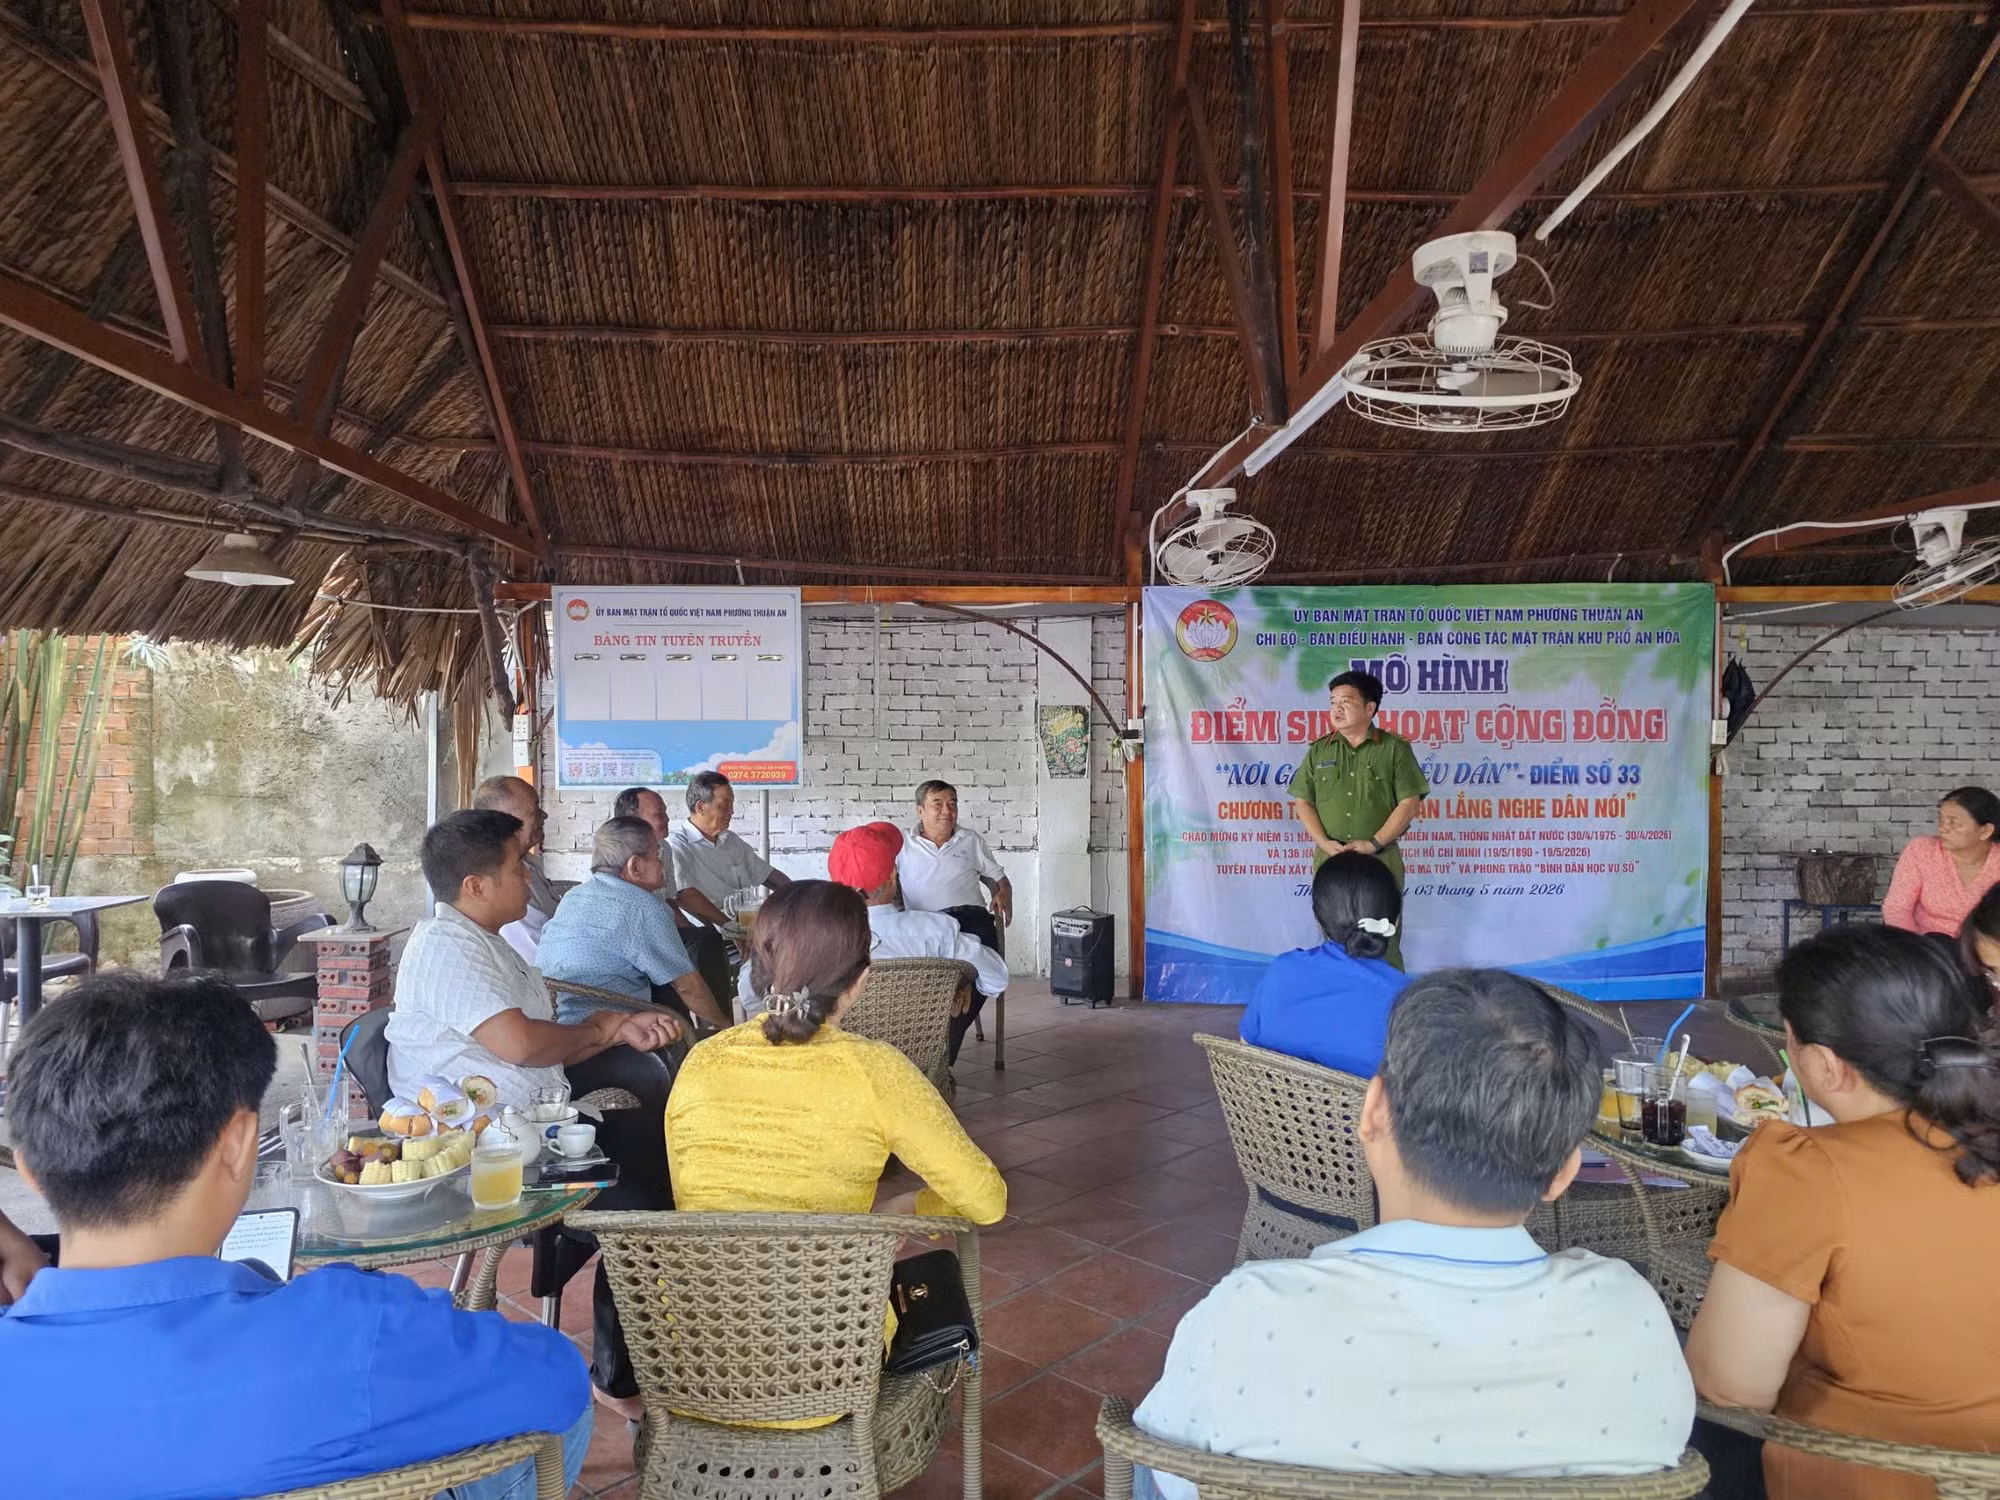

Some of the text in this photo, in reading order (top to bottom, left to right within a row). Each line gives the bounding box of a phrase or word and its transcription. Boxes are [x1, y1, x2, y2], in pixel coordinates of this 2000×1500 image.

[1314, 610, 1339, 622] BAN
[1374, 607, 1405, 624] TRẬN
[1429, 604, 1461, 623] QUỐC
[1465, 607, 1491, 624] VIỆT
[1495, 609, 1523, 621] NAM
[1582, 606, 1621, 624] THUẬN
[1626, 609, 1643, 621] AN
[594, 630, 761, 646] BẢNG TIN TUYÊN TRUYỀN
[1256, 633, 1276, 645] CHI
[1280, 630, 1296, 648] BỘ
[1310, 632, 1335, 645] BAN
[1371, 630, 1404, 645] HÀNH
[1418, 632, 1442, 645] BAN
[1447, 629, 1480, 645] CÔNG
[1485, 629, 1507, 645] TÁC
[1542, 629, 1574, 647] TRẬN
[1578, 632, 1602, 644] KHU
[1607, 627, 1631, 644] PHỐ
[1635, 632, 1652, 644] AN
[1657, 628, 1680, 643] HÒA
[1418, 653, 1508, 694] HÌNH
[1190, 697, 1668, 749] ĐIỂM SIN HOẠT CỘNG ĐỒNG
[1530, 757, 1579, 785] ĐIỂM
[1586, 758, 1614, 785] SỐ
[1618, 764, 1641, 784] 33
[1218, 800, 1282, 820] CHƯƠNG
[1446, 791, 1492, 819] LẮNG
[1498, 798, 1545, 818] NGHE
[1552, 794, 1590, 818] DÂN
[1284, 832, 1293, 842] 51
[1567, 830, 1616, 841] (30/4/1975
[1625, 830, 1672, 840] 30/4/2026)
[1283, 849, 1300, 858] 136
[1456, 848, 1481, 857] MINH
[1484, 847, 1532, 858] (19/5/1890
[1543, 847, 1590, 857] 19/5/2026)
[1216, 863, 1246, 874] TUYÊN
[1418, 864, 1431, 874] MA
[1473, 864, 1505, 873] PHONG
[1565, 861, 1584, 873] DÂN
[1587, 864, 1605, 875] HỌC
[1414, 885, 1434, 896] 03
[1437, 884, 1476, 897] tháng
[1480, 884, 1491, 895] 5
[1493, 884, 1524, 895] năm
[1529, 884, 1565, 895] 2026
